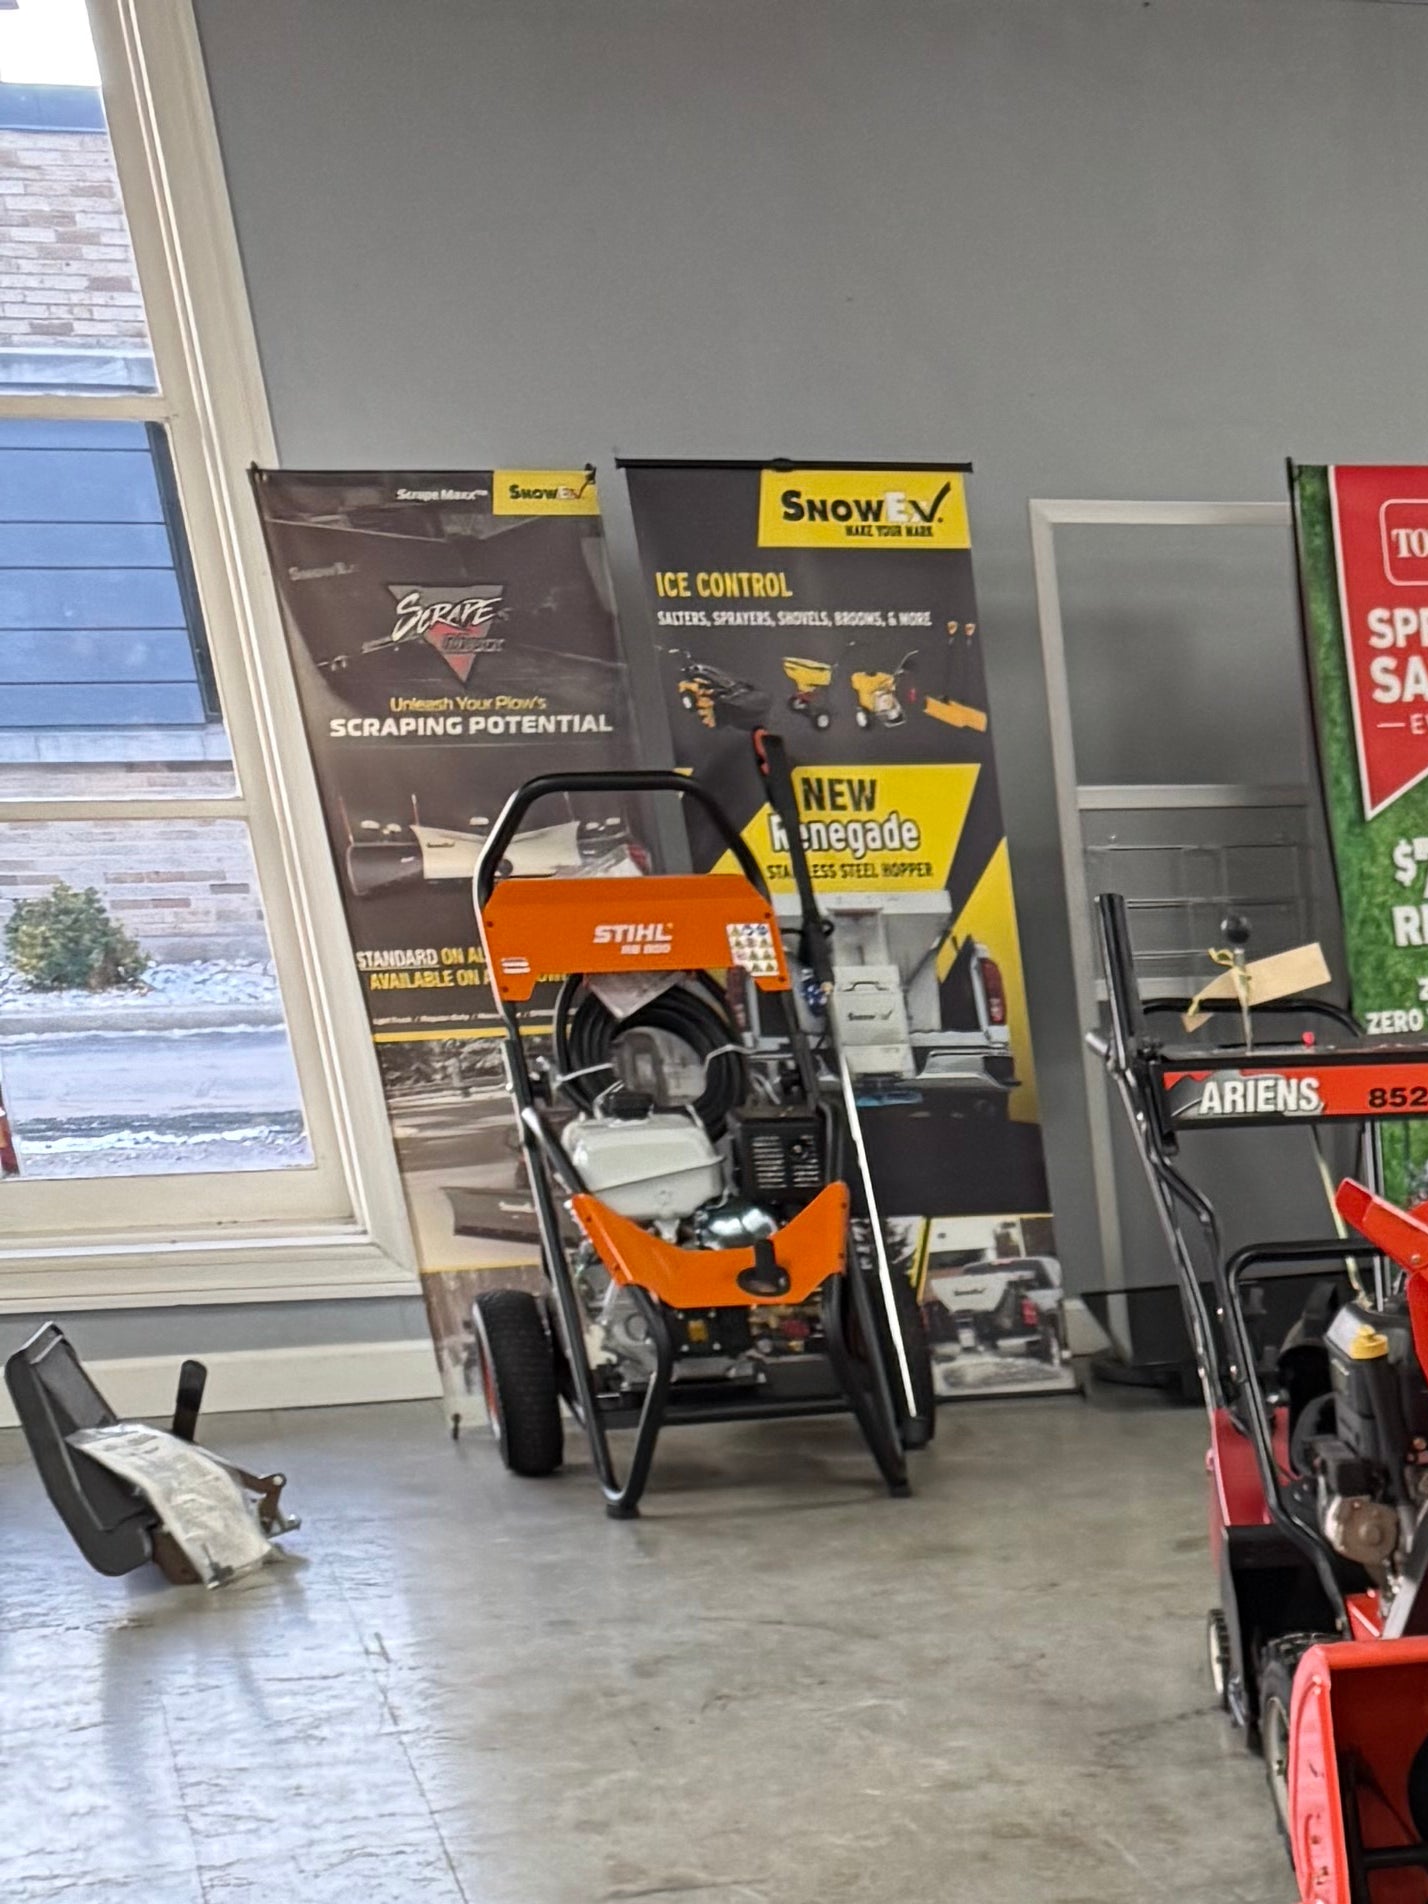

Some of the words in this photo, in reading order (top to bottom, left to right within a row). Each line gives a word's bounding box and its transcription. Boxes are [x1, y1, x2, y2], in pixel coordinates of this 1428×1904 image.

[845, 525, 874, 538] MAKE
[877, 525, 902, 537] YOUR
[905, 526, 934, 537] MARK
[656, 572, 691, 597] ICE
[696, 572, 793, 597] CONTROL
[391, 591, 503, 642] SCRAPE
[657, 611, 711, 627] SALTERS,
[713, 611, 776, 627] SPRAYERS,
[777, 611, 832, 627] SHOVELS,
[834, 612, 885, 627] BROOMS,
[899, 612, 932, 625] MORE
[390, 697, 452, 712] Unleash
[456, 697, 492, 711] Your
[330, 716, 462, 737] SCRAPING
[469, 714, 613, 735] POTENTIAL
[800, 777, 877, 811] NEW
[767, 863, 837, 880] STALESS
[840, 863, 879, 878] STEEL
[881, 862, 934, 878] HOPPER
[593, 923, 672, 943] STIHL
[357, 948, 438, 968] STANDARD
[441, 947, 464, 965] ON
[370, 970, 454, 990] AVAILABLE
[457, 969, 480, 986] ON
[1365, 1011, 1424, 1035] ZERO
[1199, 1077, 1322, 1114] ARIENS
